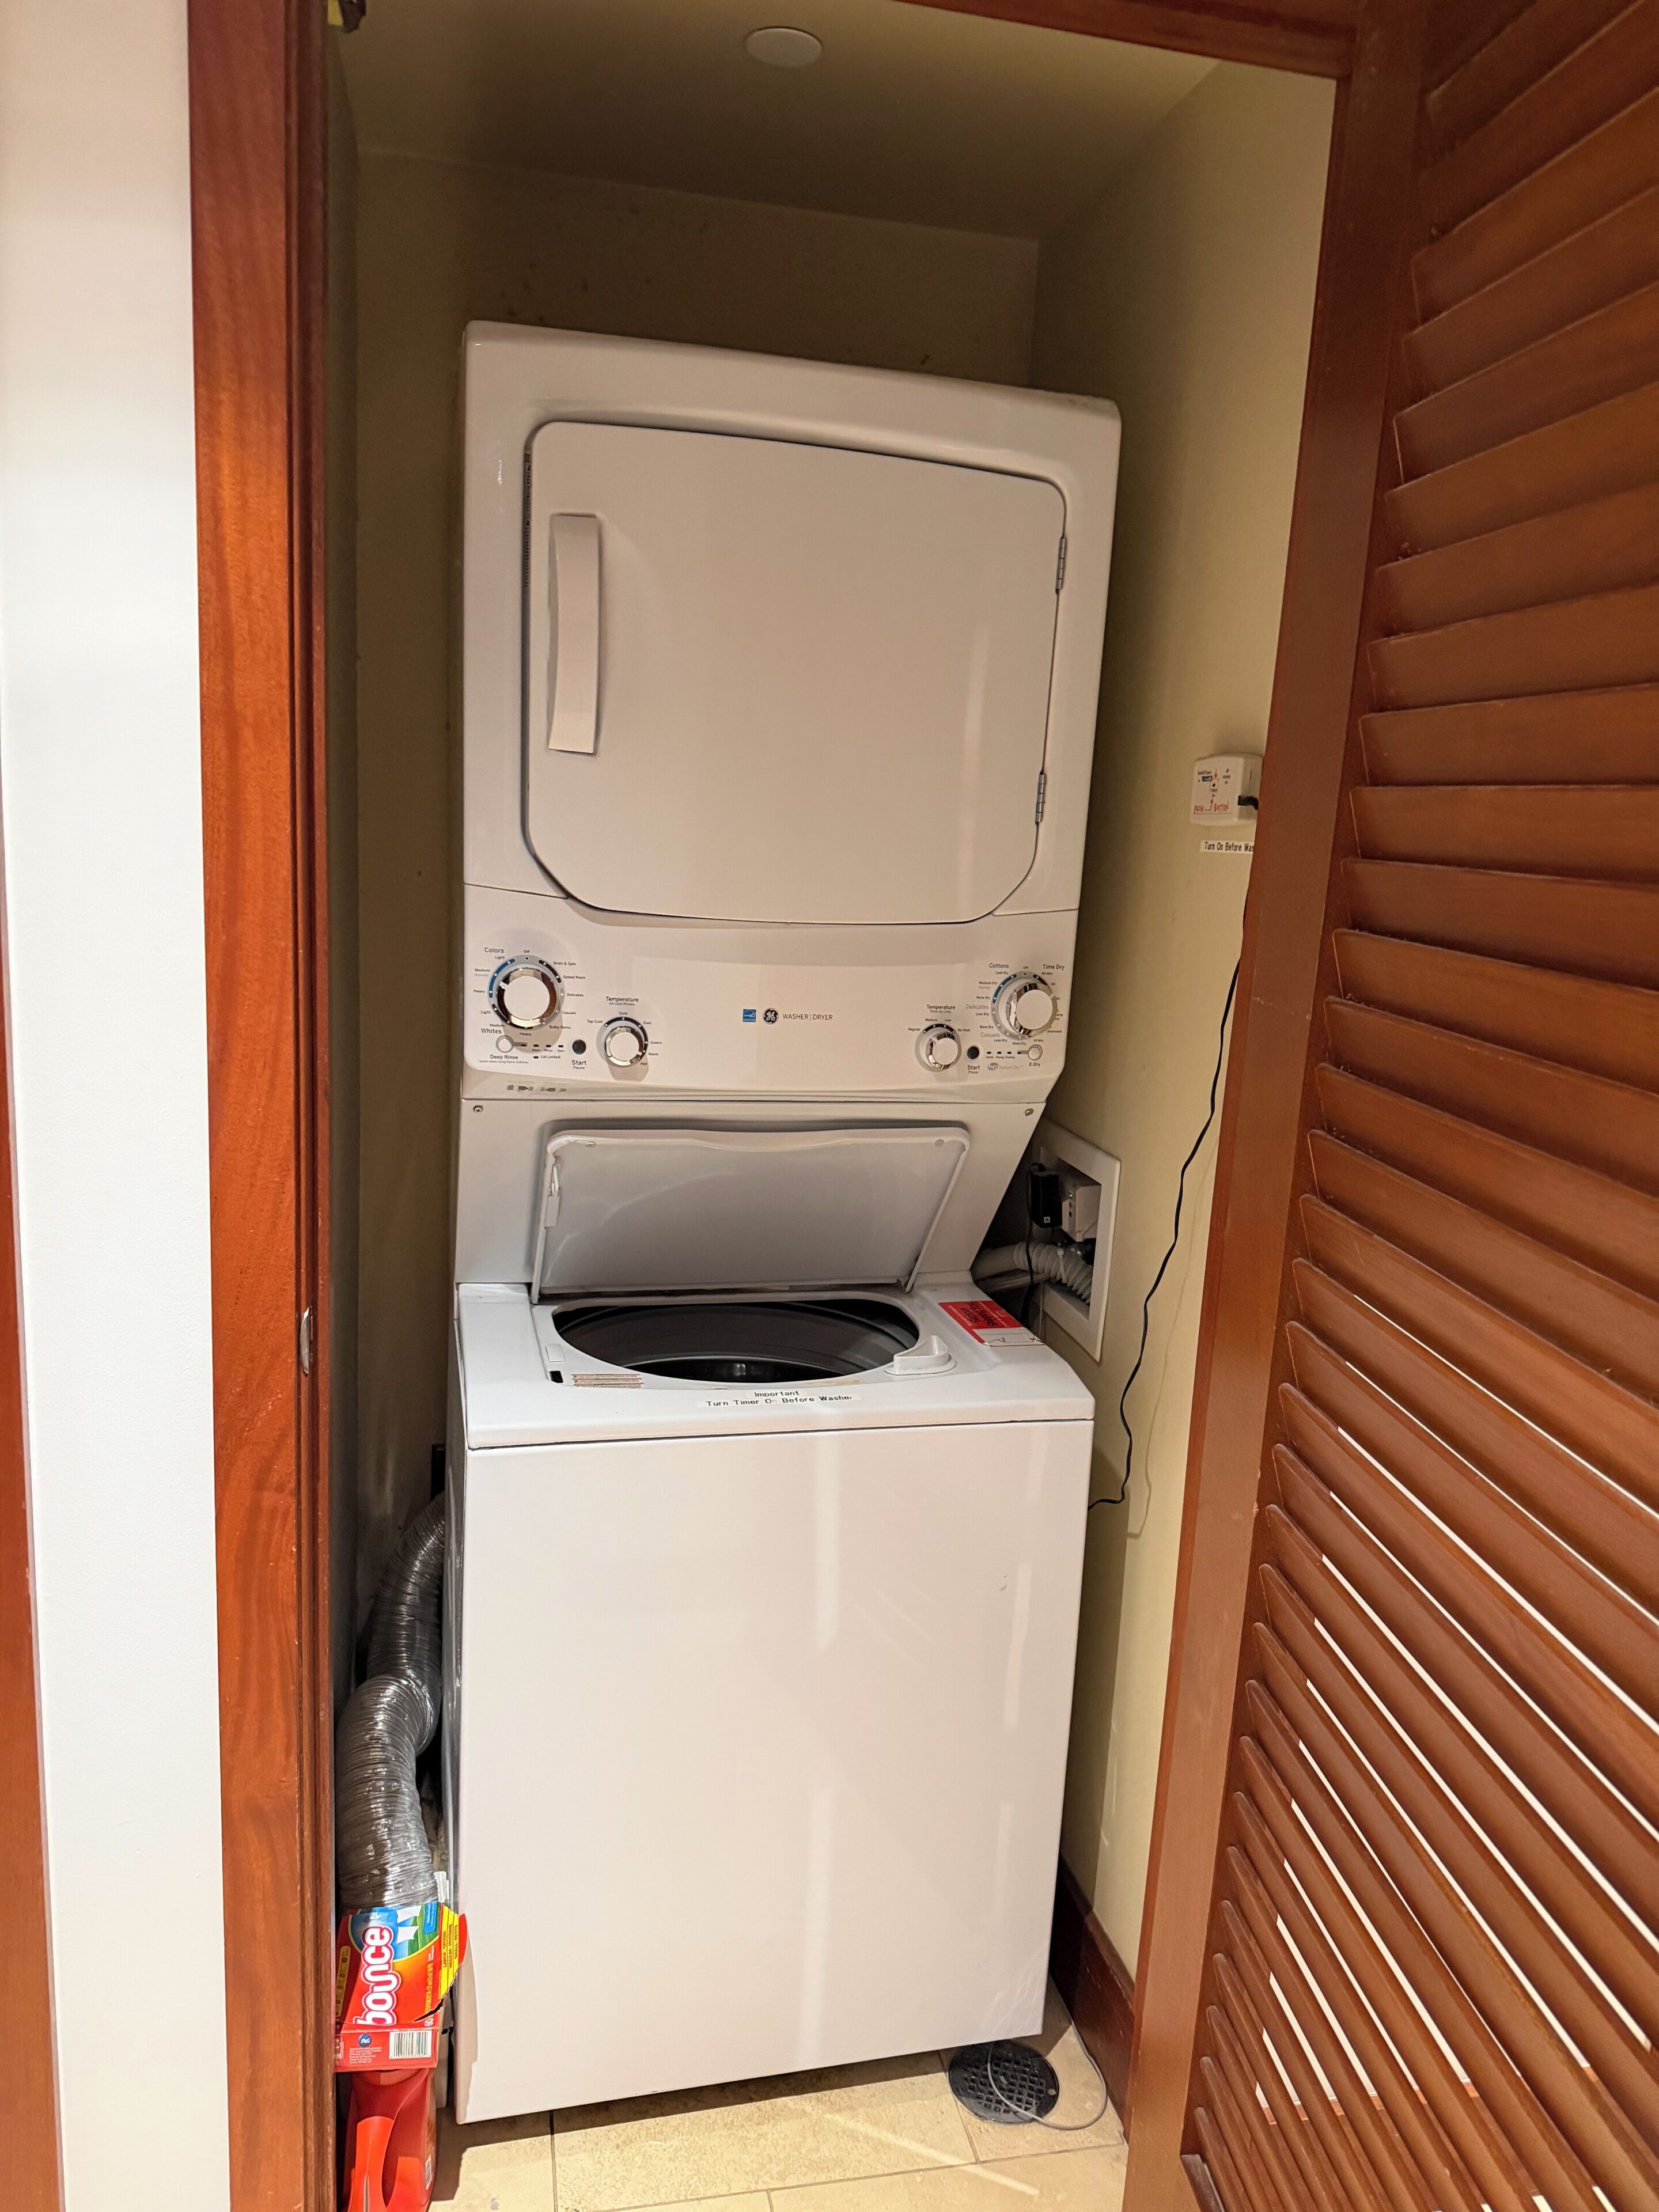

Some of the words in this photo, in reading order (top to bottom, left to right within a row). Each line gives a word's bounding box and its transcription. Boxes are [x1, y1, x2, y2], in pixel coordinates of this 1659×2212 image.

[1205, 842, 1215, 850] Turn
[1217, 842, 1223, 851] On
[1225, 842, 1242, 851] Before
[354, 1927, 400, 2025] bounce
